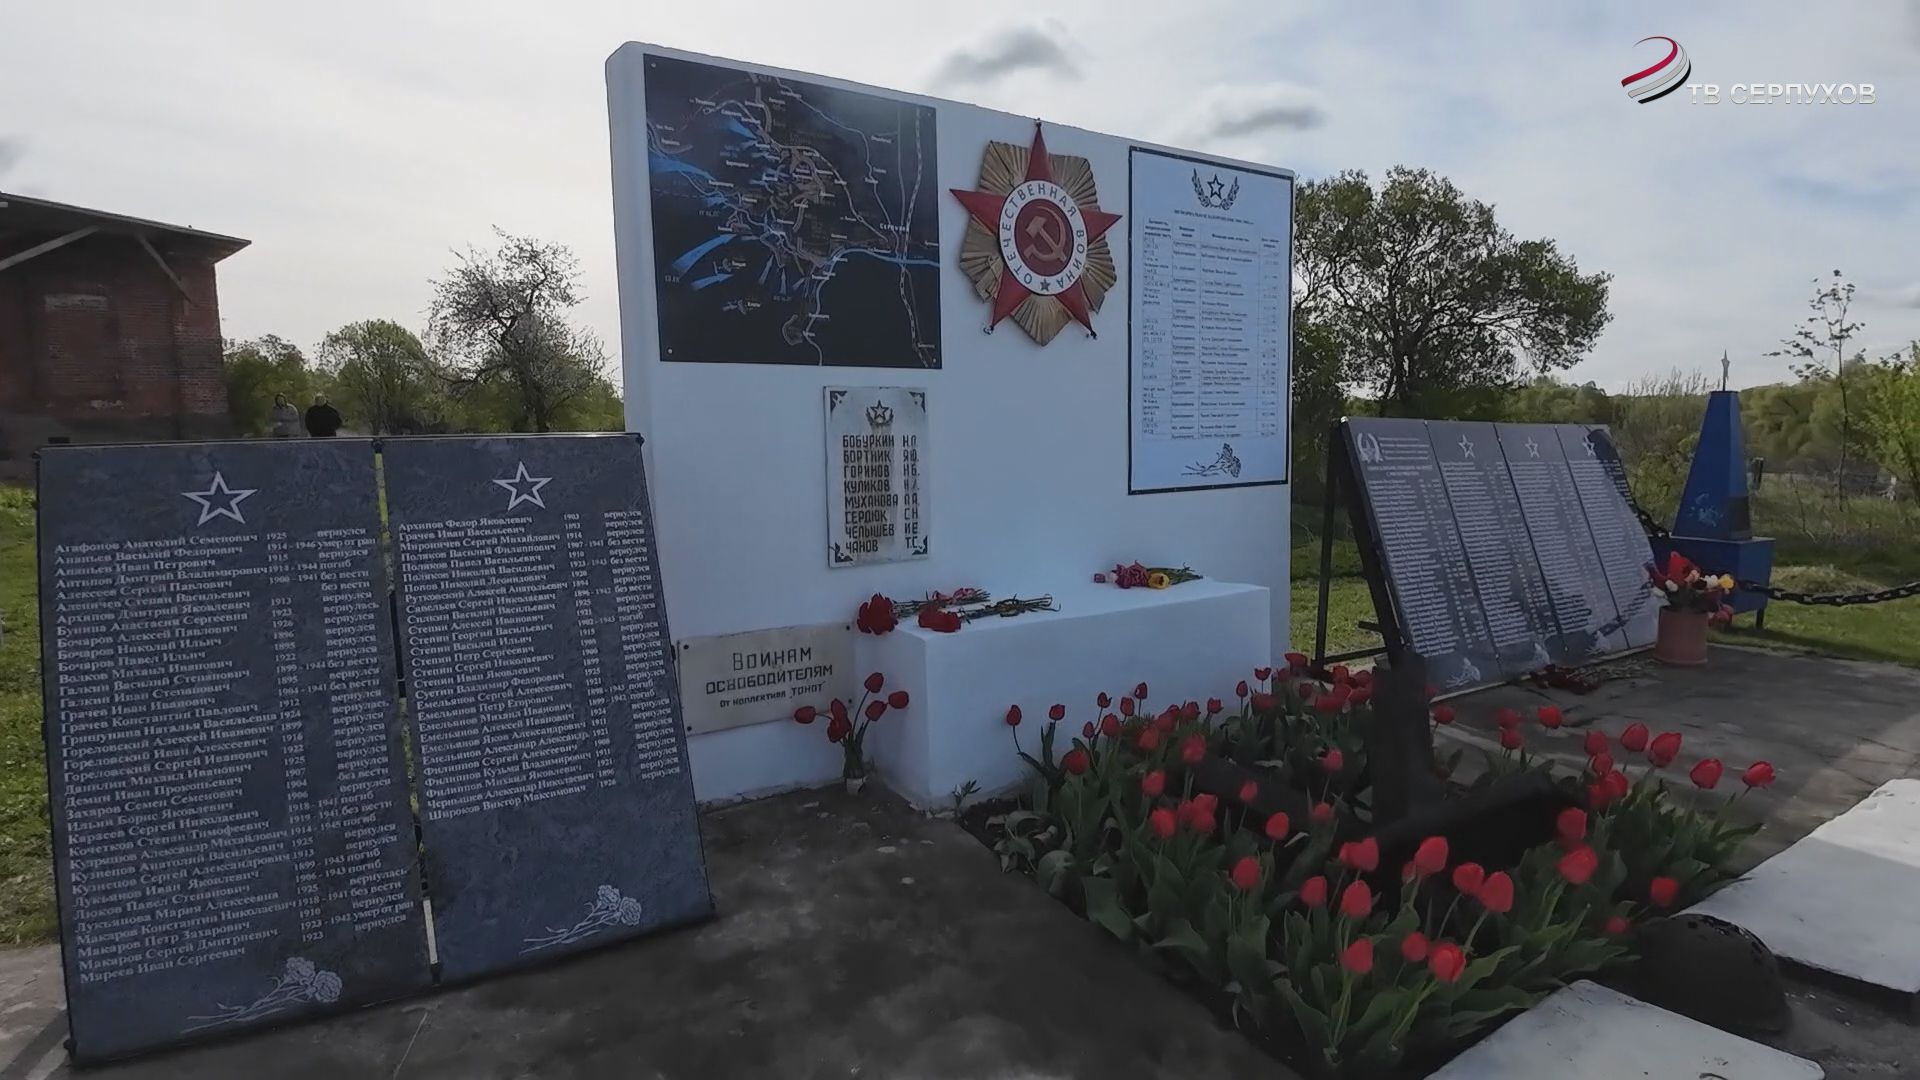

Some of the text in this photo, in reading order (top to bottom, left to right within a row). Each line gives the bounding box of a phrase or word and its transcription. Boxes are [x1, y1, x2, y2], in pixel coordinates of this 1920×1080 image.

[1002, 182, 1076, 285] ОТЕЧЕСТВЕННАЯ
[842, 434, 895, 448] БОБУРКИН
[843, 449, 892, 464] БОРТНИК
[843, 464, 890, 479] ГОРИНОВ
[843, 479, 891, 494] КУЛИКОВ
[844, 493, 899, 509] МУХАНОВА
[845, 509, 888, 525] СЕРДЮК
[316, 528, 366, 537] вернулся
[462, 537, 497, 546] Сергей
[845, 539, 879, 554] ЧАНОВ
[115, 563, 149, 571] Иван
[153, 559, 215, 569] Петрович
[318, 549, 368, 558] вернулся
[56, 637, 113, 647] Бочаров
[117, 629, 170, 641] Алексей
[323, 614, 374, 623] вернулся
[326, 646, 377, 657] вернулся
[732, 647, 812, 671] ВОИНАМ
[114, 693, 148, 701] Иван
[328, 668, 379, 679] вернулся
[477, 689, 513, 700] Сергей
[61, 721, 108, 733] Грачев
[330, 690, 381, 701] вернулся
[719, 700, 730, 708] ОТ
[153, 748, 188, 758] Иван
[333, 723, 384, 735] вернулся
[153, 756, 200, 770] Сергей
[335, 734, 386, 746] вернулся
[336, 745, 387, 757] вернулся
[115, 790, 149, 800] Иван
[337, 757, 388, 769] вернулся
[128, 820, 175, 835] Сергей
[340, 791, 374, 803] погиб
[144, 934, 179, 946] Петр
[351, 893, 404, 907] вернулся
[137, 960, 173, 973] Иван
[354, 915, 406, 930] вернулся
